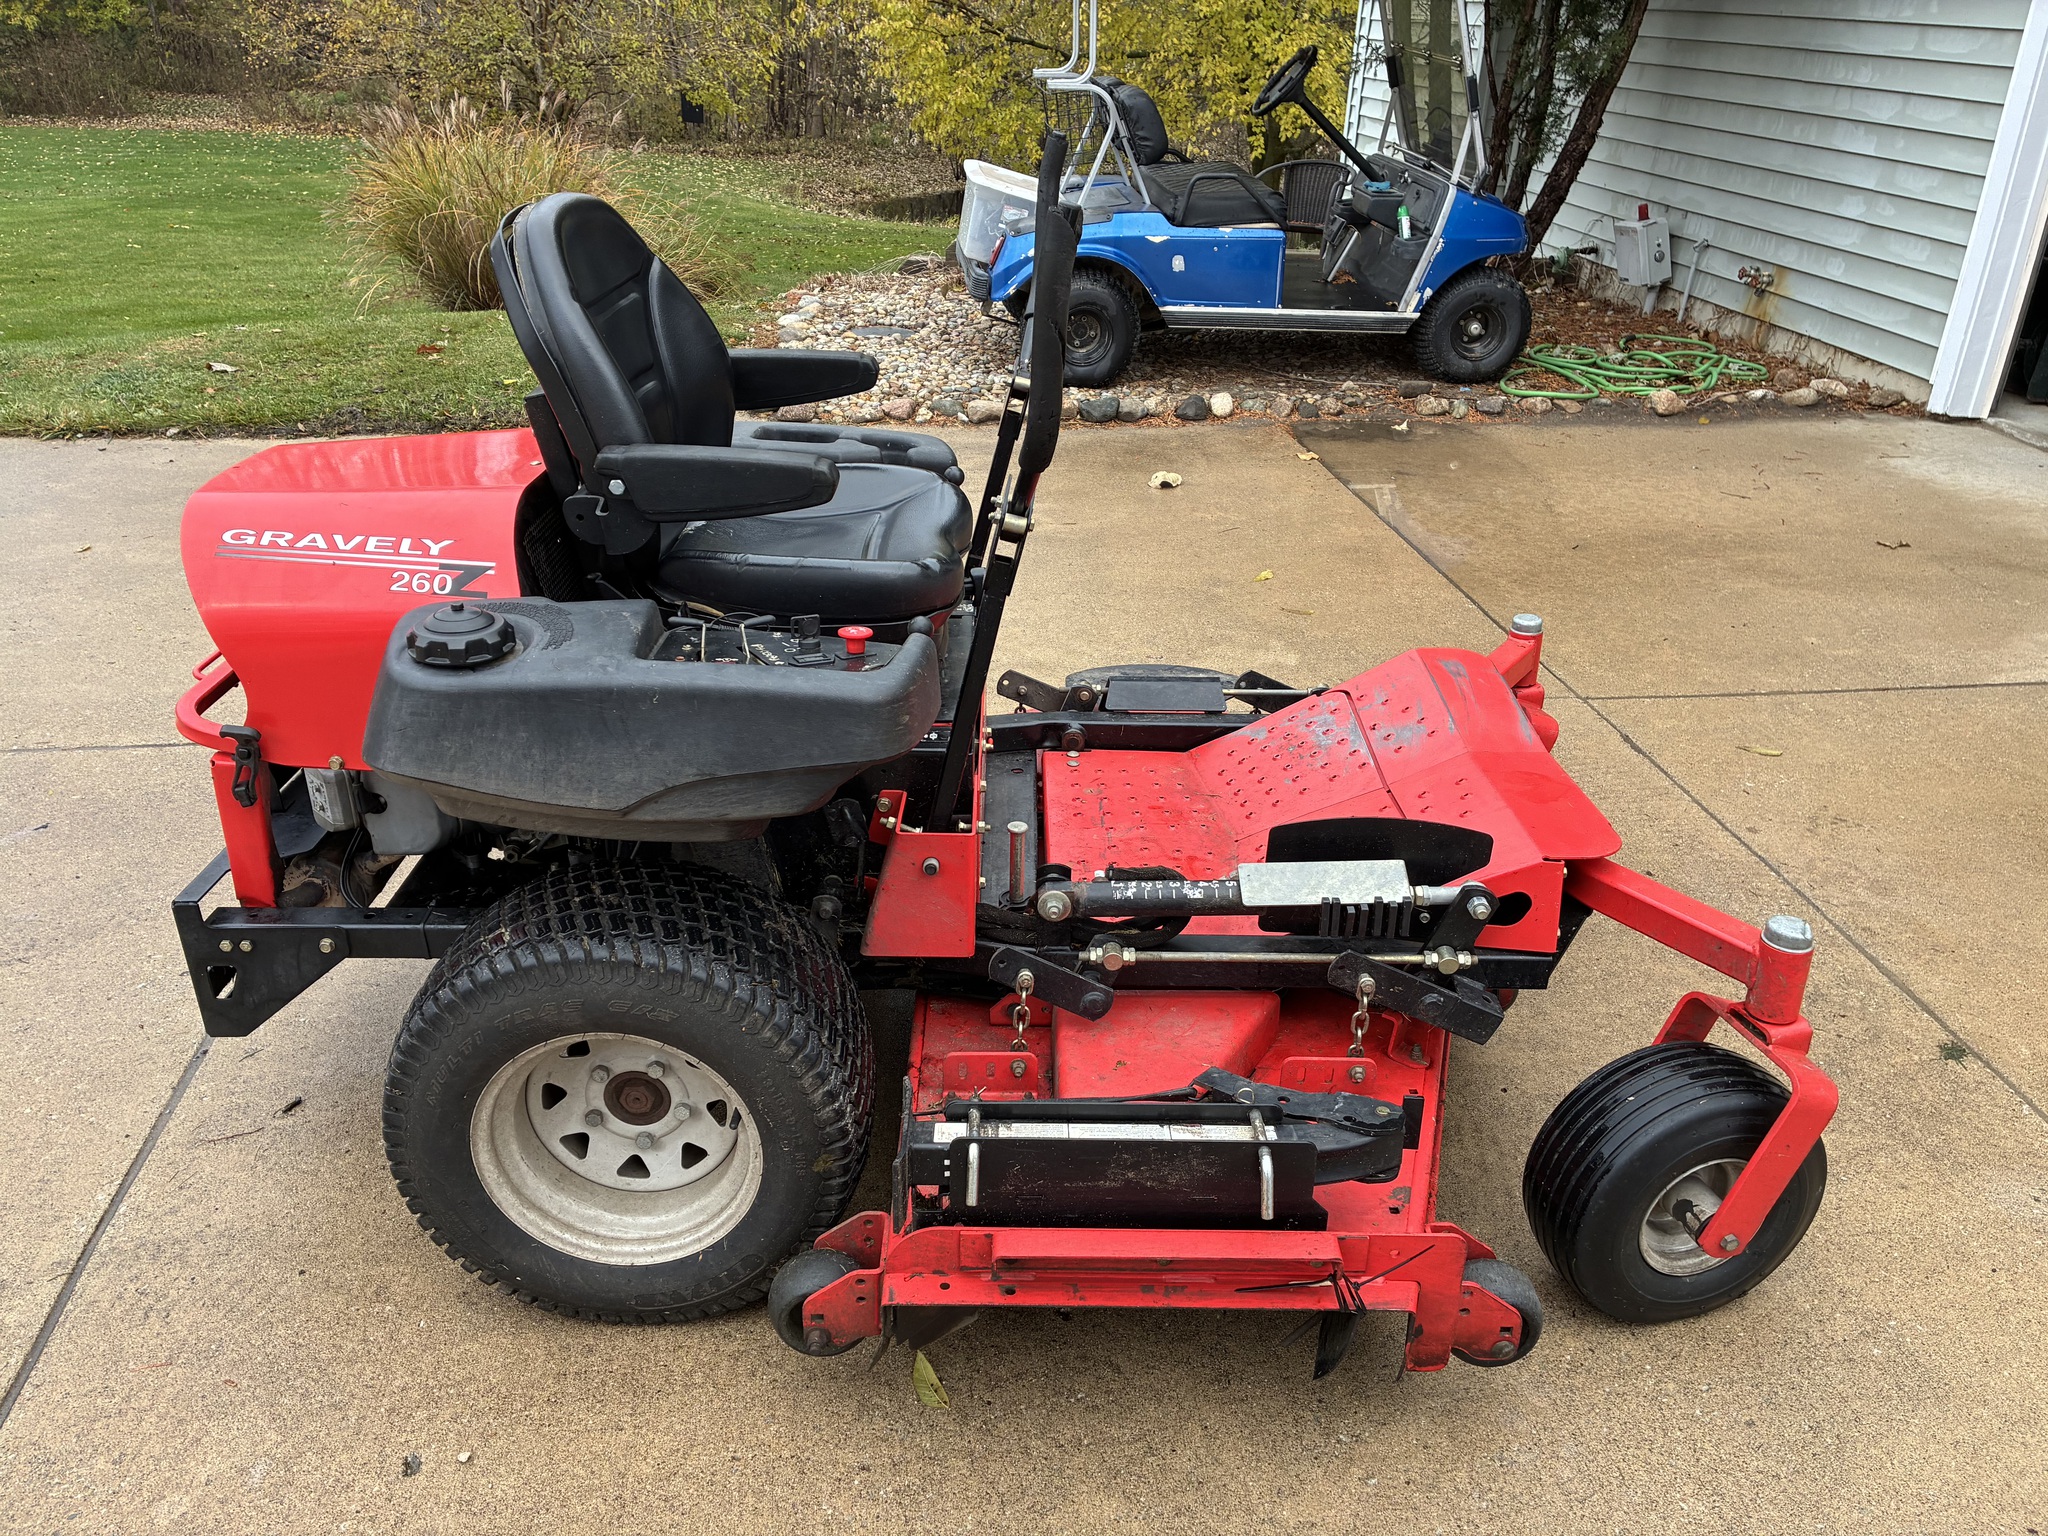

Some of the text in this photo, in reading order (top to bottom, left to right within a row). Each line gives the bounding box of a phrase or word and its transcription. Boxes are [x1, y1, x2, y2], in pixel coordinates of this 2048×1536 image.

[221, 528, 455, 556] GRAVELY
[425, 1030, 484, 1106] MULTI
[494, 999, 584, 1031] TRAC
